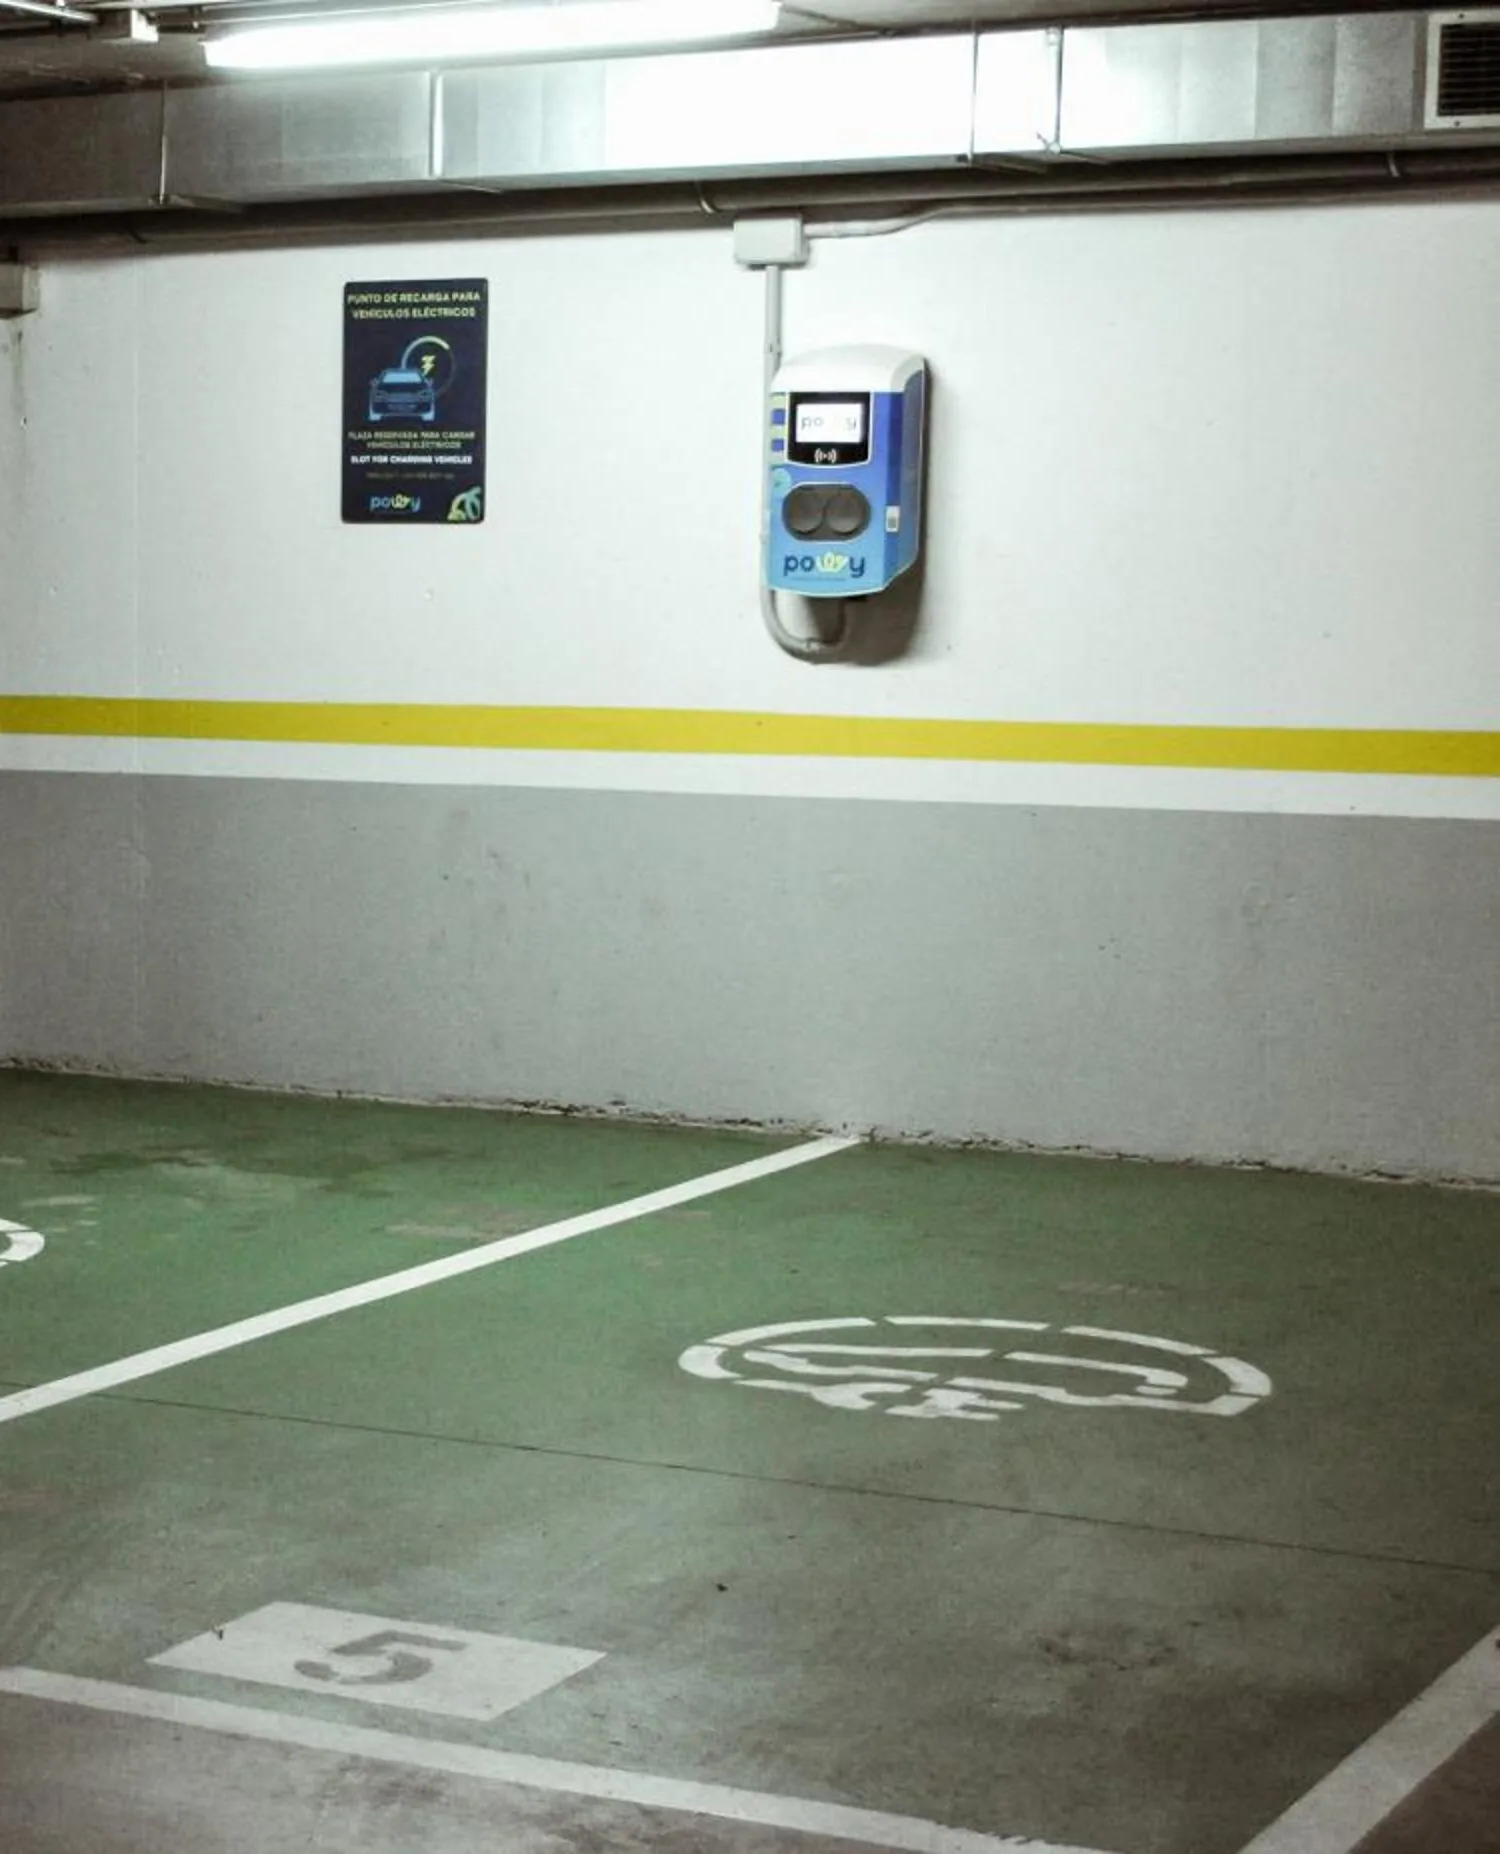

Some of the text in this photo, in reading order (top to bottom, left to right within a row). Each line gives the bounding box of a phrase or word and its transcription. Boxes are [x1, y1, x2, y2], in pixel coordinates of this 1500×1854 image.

[348, 291, 481, 304] PUNTO DE RECARGA PARA
[412, 305, 476, 318] ELÉCTRICOS
[800, 416, 857, 431] poy
[421, 431, 440, 440] PARA
[350, 455, 473, 464] SLOT FOR CHARGING VEHICLES
[293, 1629, 471, 1686] 5
